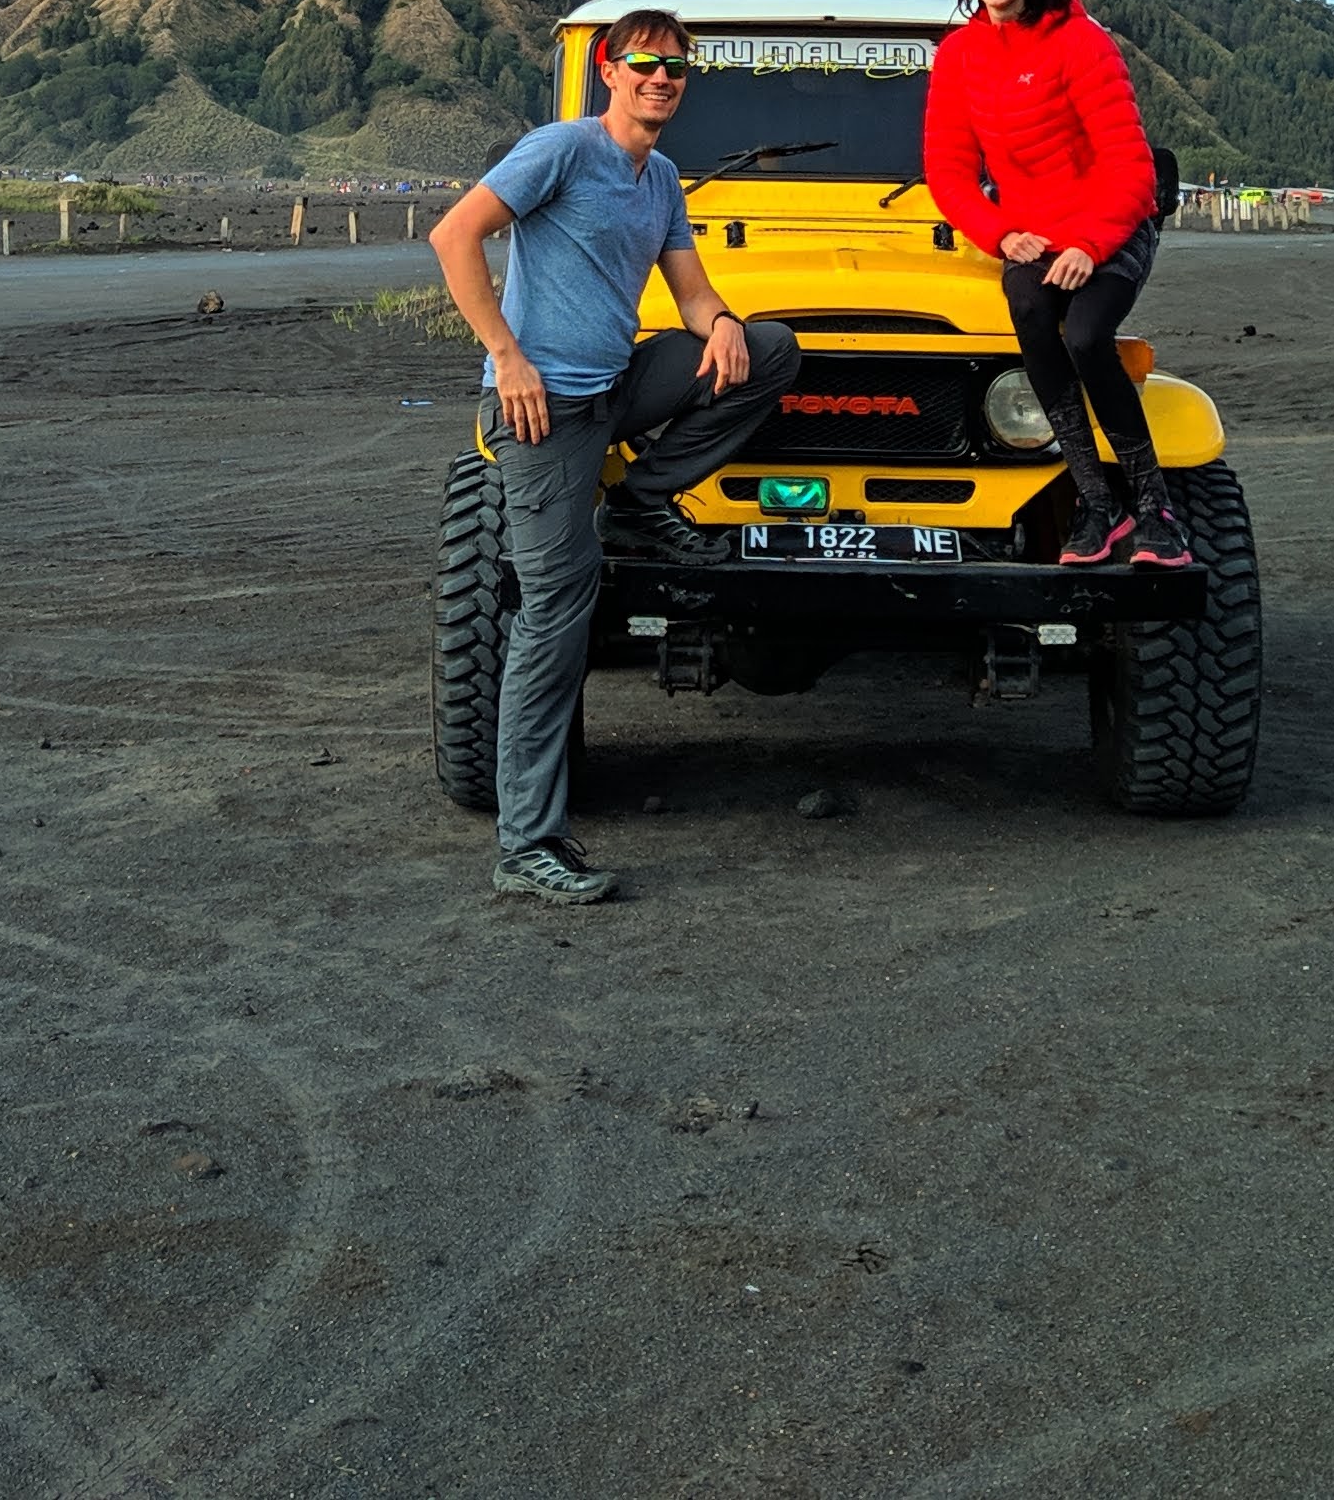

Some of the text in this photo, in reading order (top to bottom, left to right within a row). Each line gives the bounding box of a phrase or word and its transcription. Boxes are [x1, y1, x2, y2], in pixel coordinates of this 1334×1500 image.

[694, 41, 754, 65] TU
[763, 41, 926, 67] MALAM
[778, 395, 920, 416] TOYOTA
[750, 526, 954, 553] N 1822 NE
